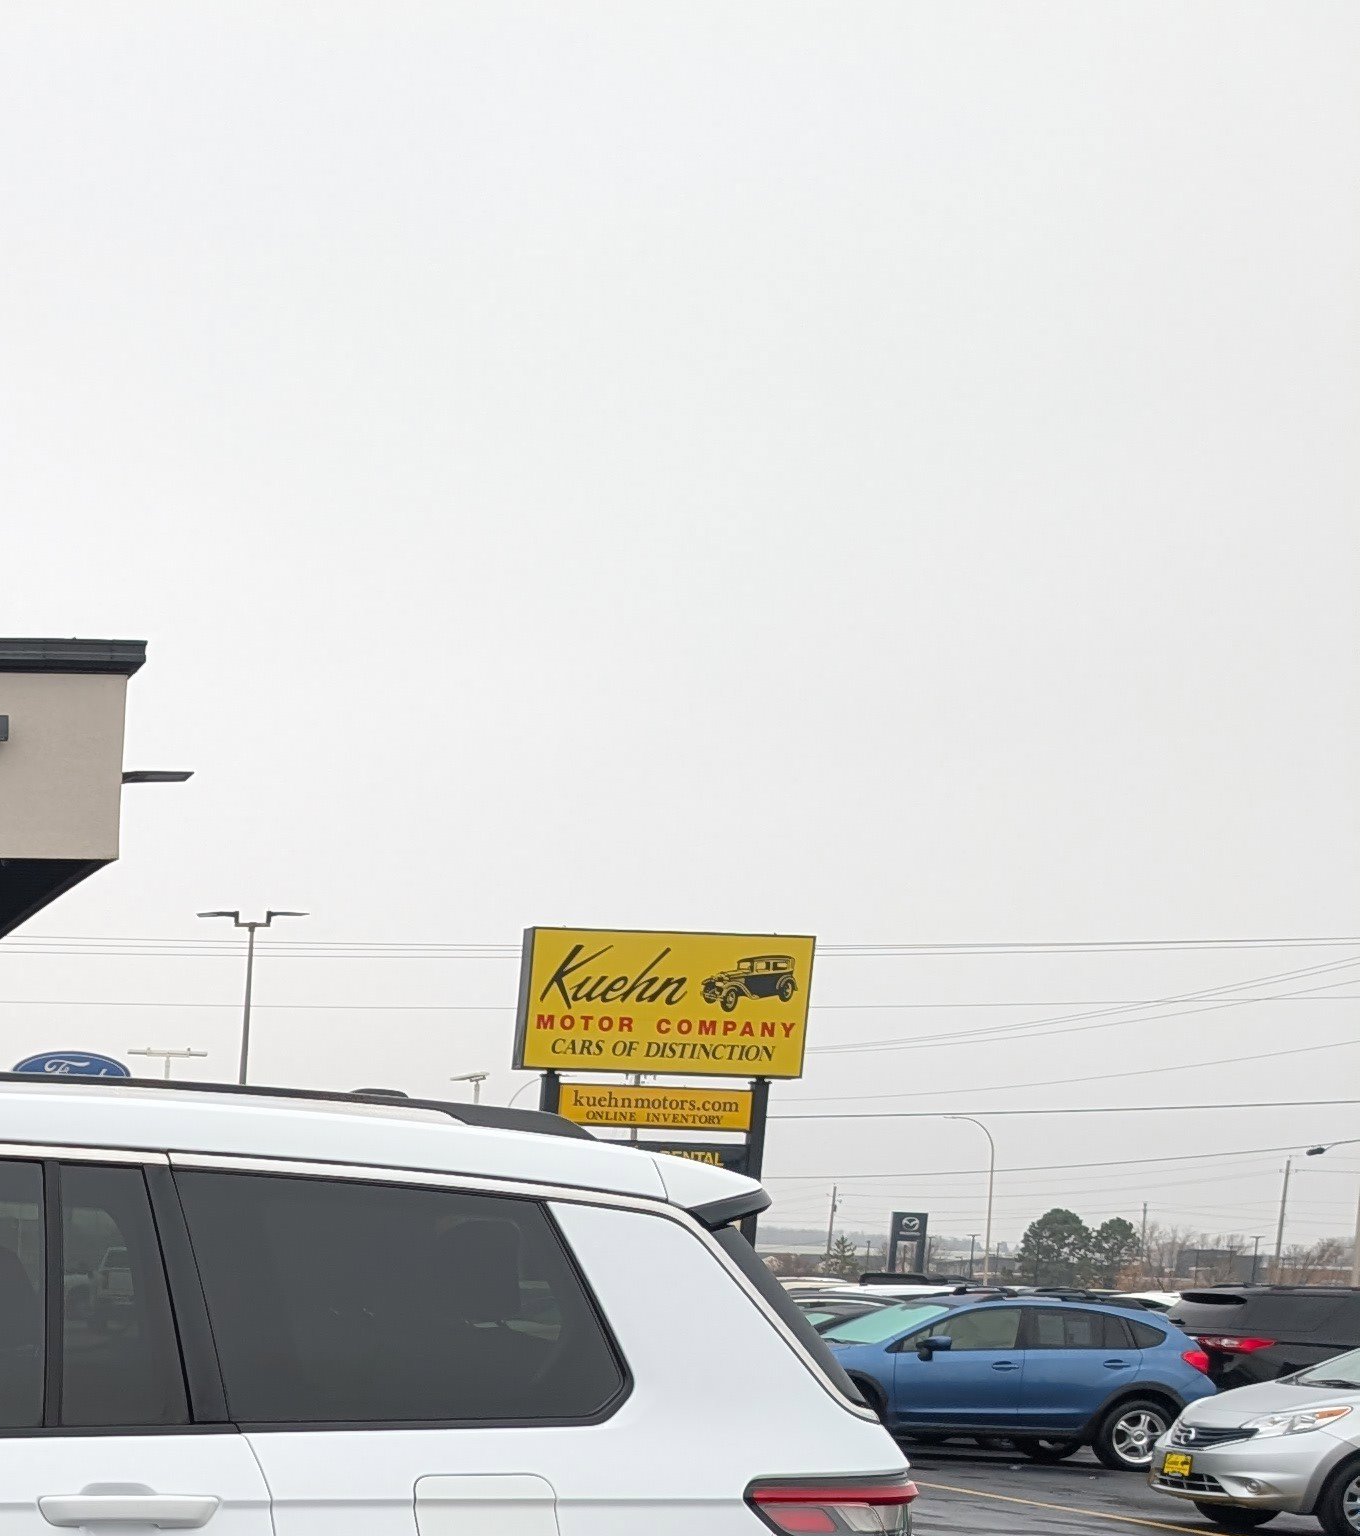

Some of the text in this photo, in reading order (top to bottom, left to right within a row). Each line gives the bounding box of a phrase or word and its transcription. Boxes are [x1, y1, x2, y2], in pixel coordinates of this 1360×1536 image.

[539, 943, 689, 1010] Kuehn
[535, 1014, 796, 1039] MOTOR COMPANY
[551, 1037, 776, 1062] CARS OF DISTINCTION
[573, 1089, 739, 1113] kuehnmotors.com
[585, 1110, 724, 1126] ONLINE INVENTORY
[660, 1150, 724, 1167] NTAL
